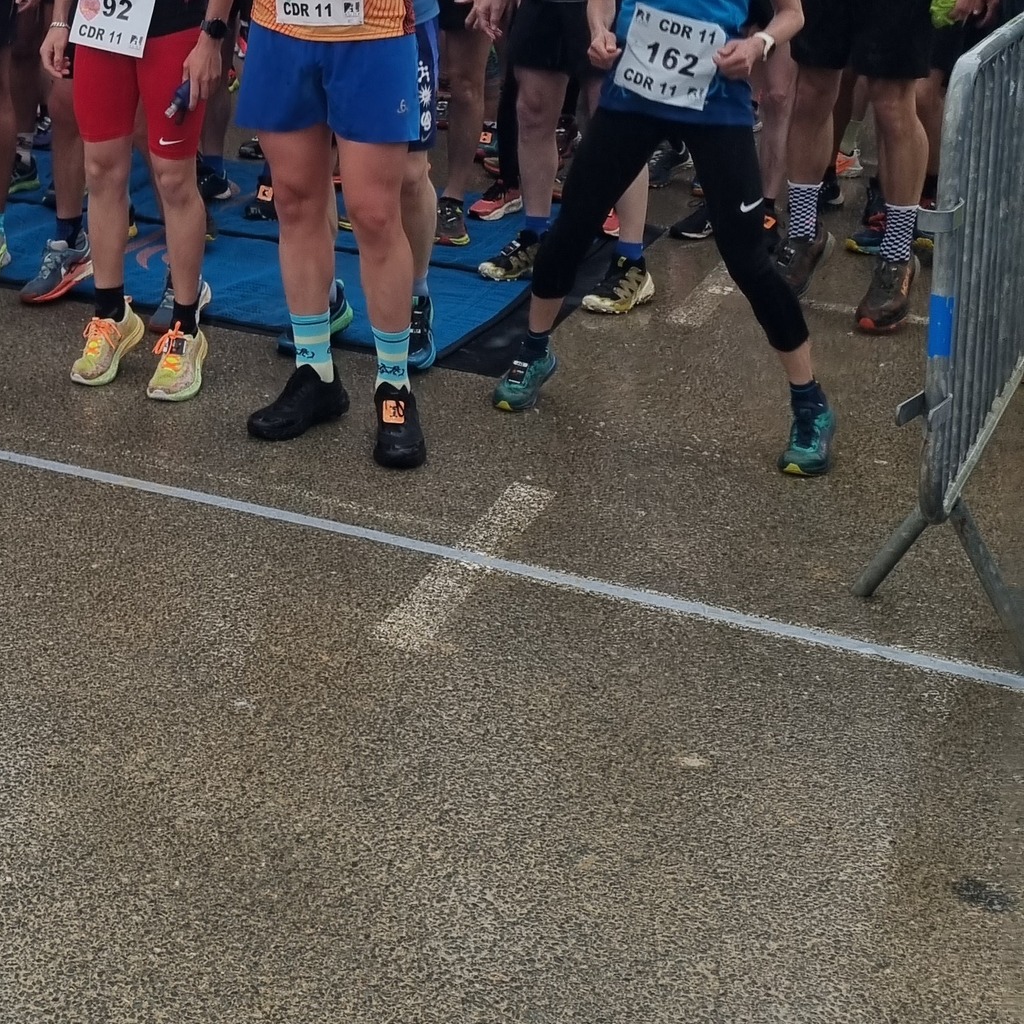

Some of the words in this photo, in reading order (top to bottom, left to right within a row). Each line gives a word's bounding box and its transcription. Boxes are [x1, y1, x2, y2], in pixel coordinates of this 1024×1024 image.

[283, 1, 310, 18] CDR
[315, 3, 333, 18] 11
[78, 24, 105, 42] CDR
[109, 31, 123, 46] 11
[659, 18, 693, 40] CDR
[698, 28, 717, 46] 11
[647, 41, 699, 78] 162
[623, 68, 654, 92] CDR
[659, 81, 678, 98] 11
